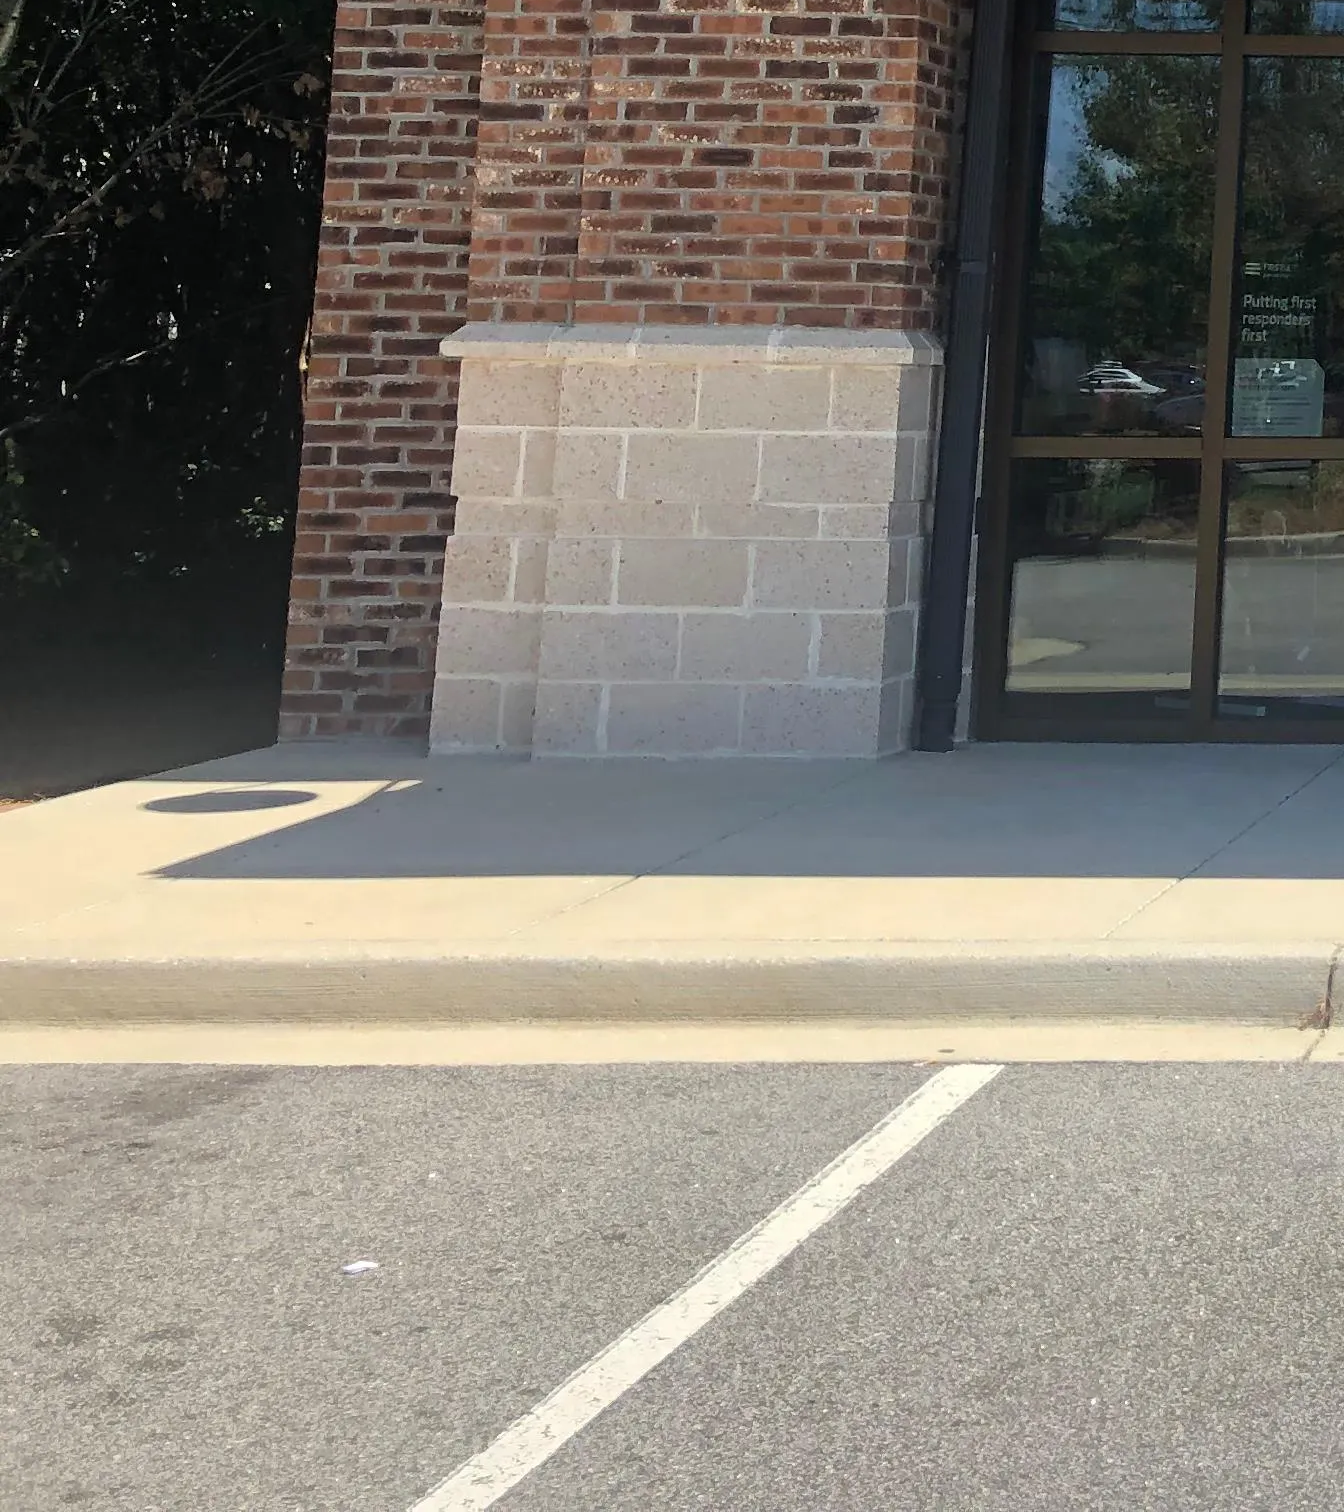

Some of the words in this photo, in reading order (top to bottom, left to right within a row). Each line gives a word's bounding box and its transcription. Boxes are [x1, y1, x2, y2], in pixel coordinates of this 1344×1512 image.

[1243, 294, 1288, 311] Putting
[1291, 295, 1317, 309] first
[1242, 313, 1311, 328] responders
[1241, 327, 1268, 342] first
